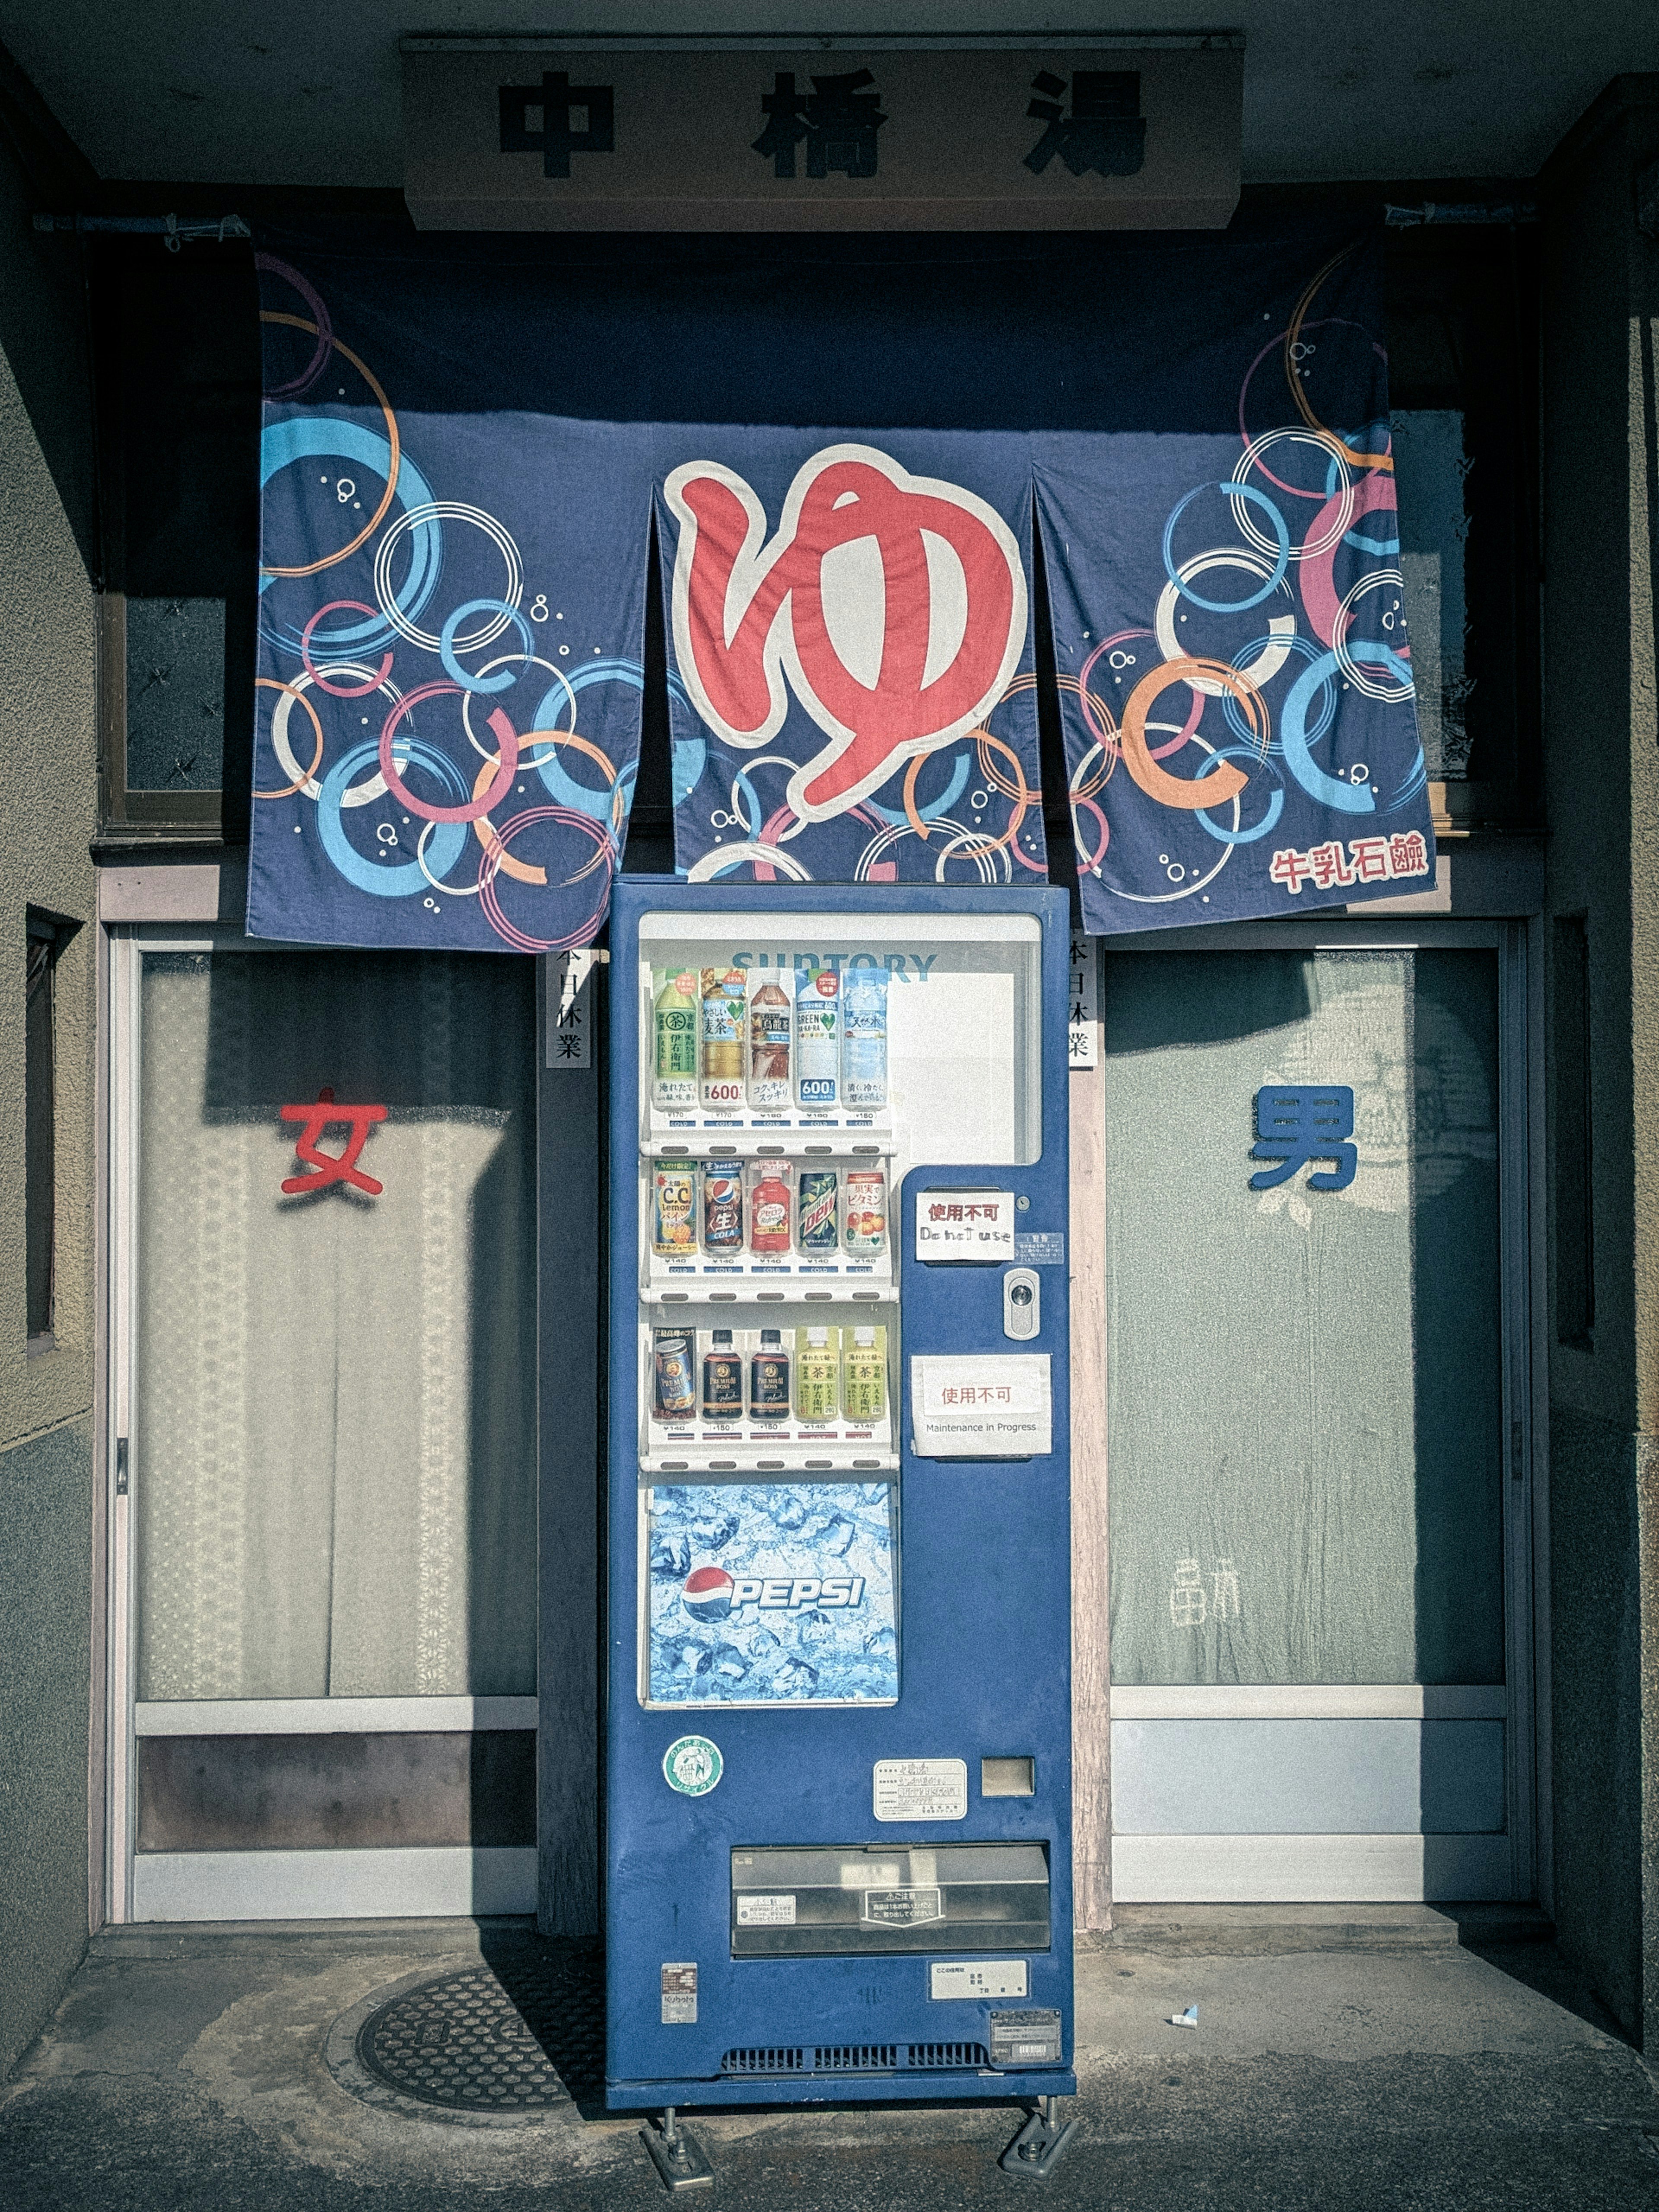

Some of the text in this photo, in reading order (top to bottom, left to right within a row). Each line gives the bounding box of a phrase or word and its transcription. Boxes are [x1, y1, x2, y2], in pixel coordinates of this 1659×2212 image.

[498, 68, 1146, 179] 中橋湯
[670, 448, 1024, 817] ゆ
[705, 1018, 727, 1035] 麦茶
[280, 1087, 388, 1195] 女
[1252, 1085, 1358, 1189] 男
[855, 1185, 880, 1194] 果実で
[848, 1195, 882, 1206] ビタミン
[928, 1203, 1000, 1222] 使用不可
[714, 1231, 734, 1240] COLA
[978, 1231, 1011, 1243] use
[812, 1367, 824, 1379] 茶
[860, 1367, 871, 1379] 茶
[941, 1386, 1011, 1405] 使用不可
[927, 1424, 983, 1433] Maintenance
[998, 1423, 1036, 1433] Progress
[729, 1577, 865, 1609] PEPSI
